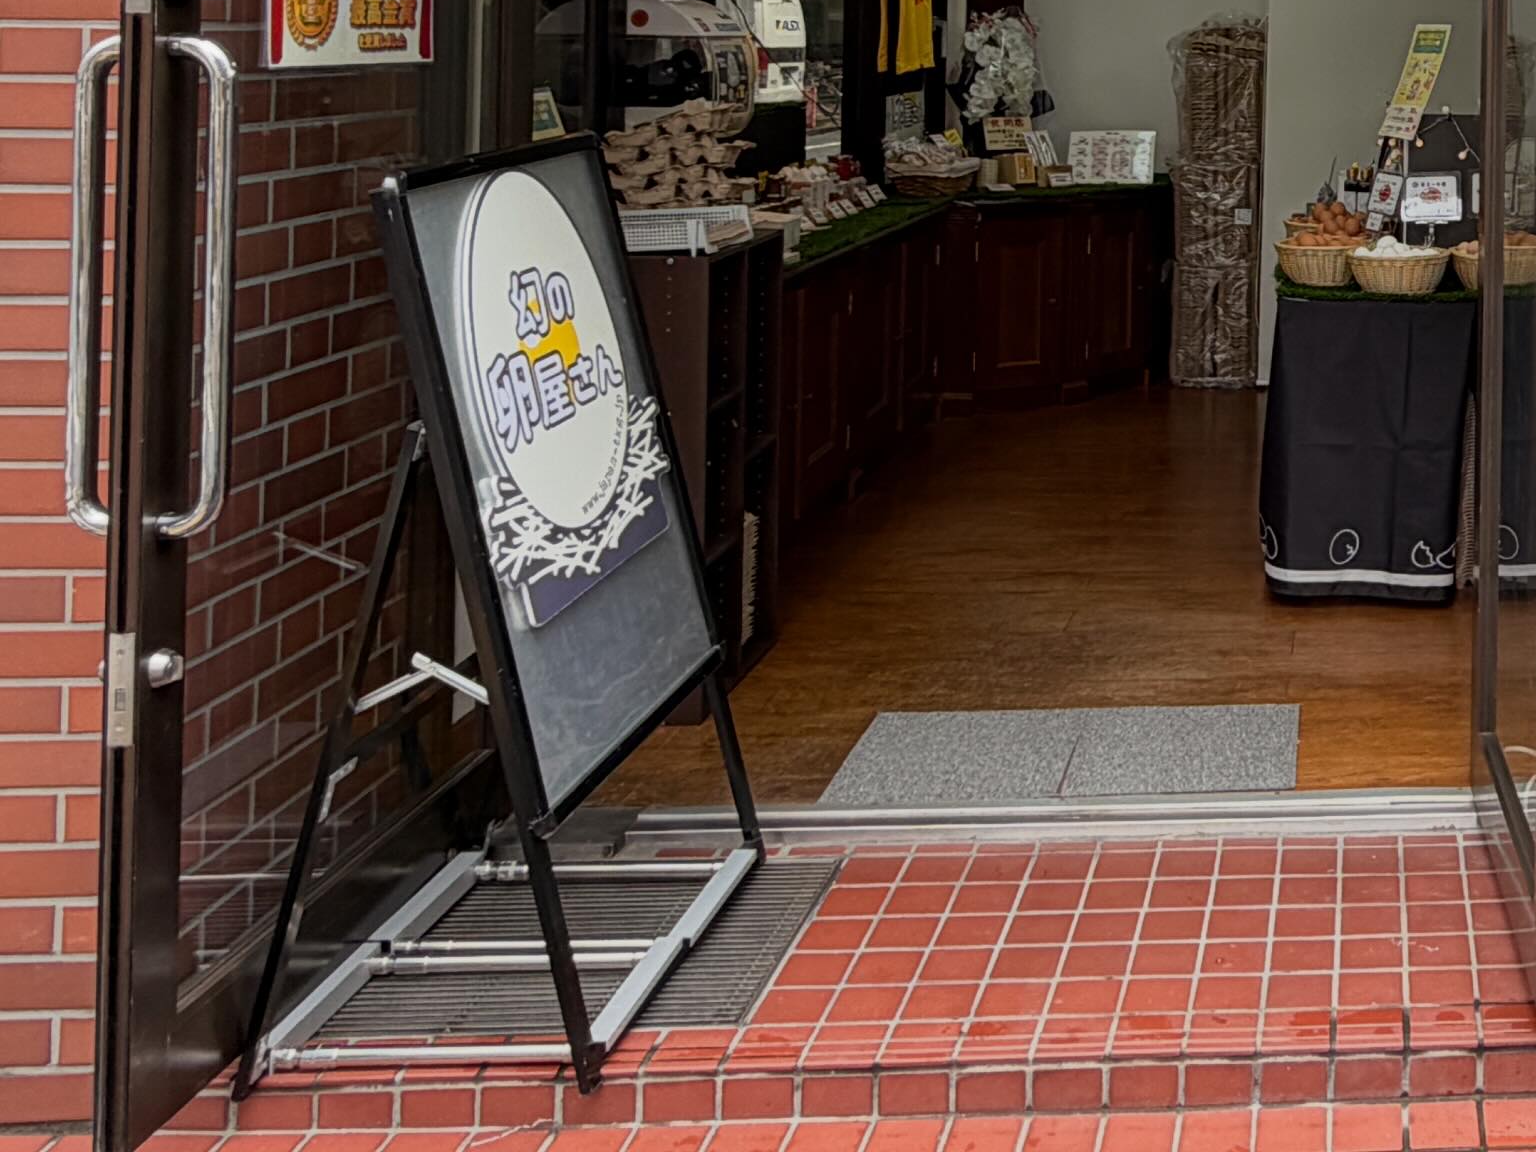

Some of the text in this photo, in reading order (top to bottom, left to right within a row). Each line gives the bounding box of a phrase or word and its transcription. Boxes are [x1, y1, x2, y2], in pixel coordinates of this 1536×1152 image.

[508, 267, 575, 338] 幻の
[487, 344, 624, 454] 卵屋さん
